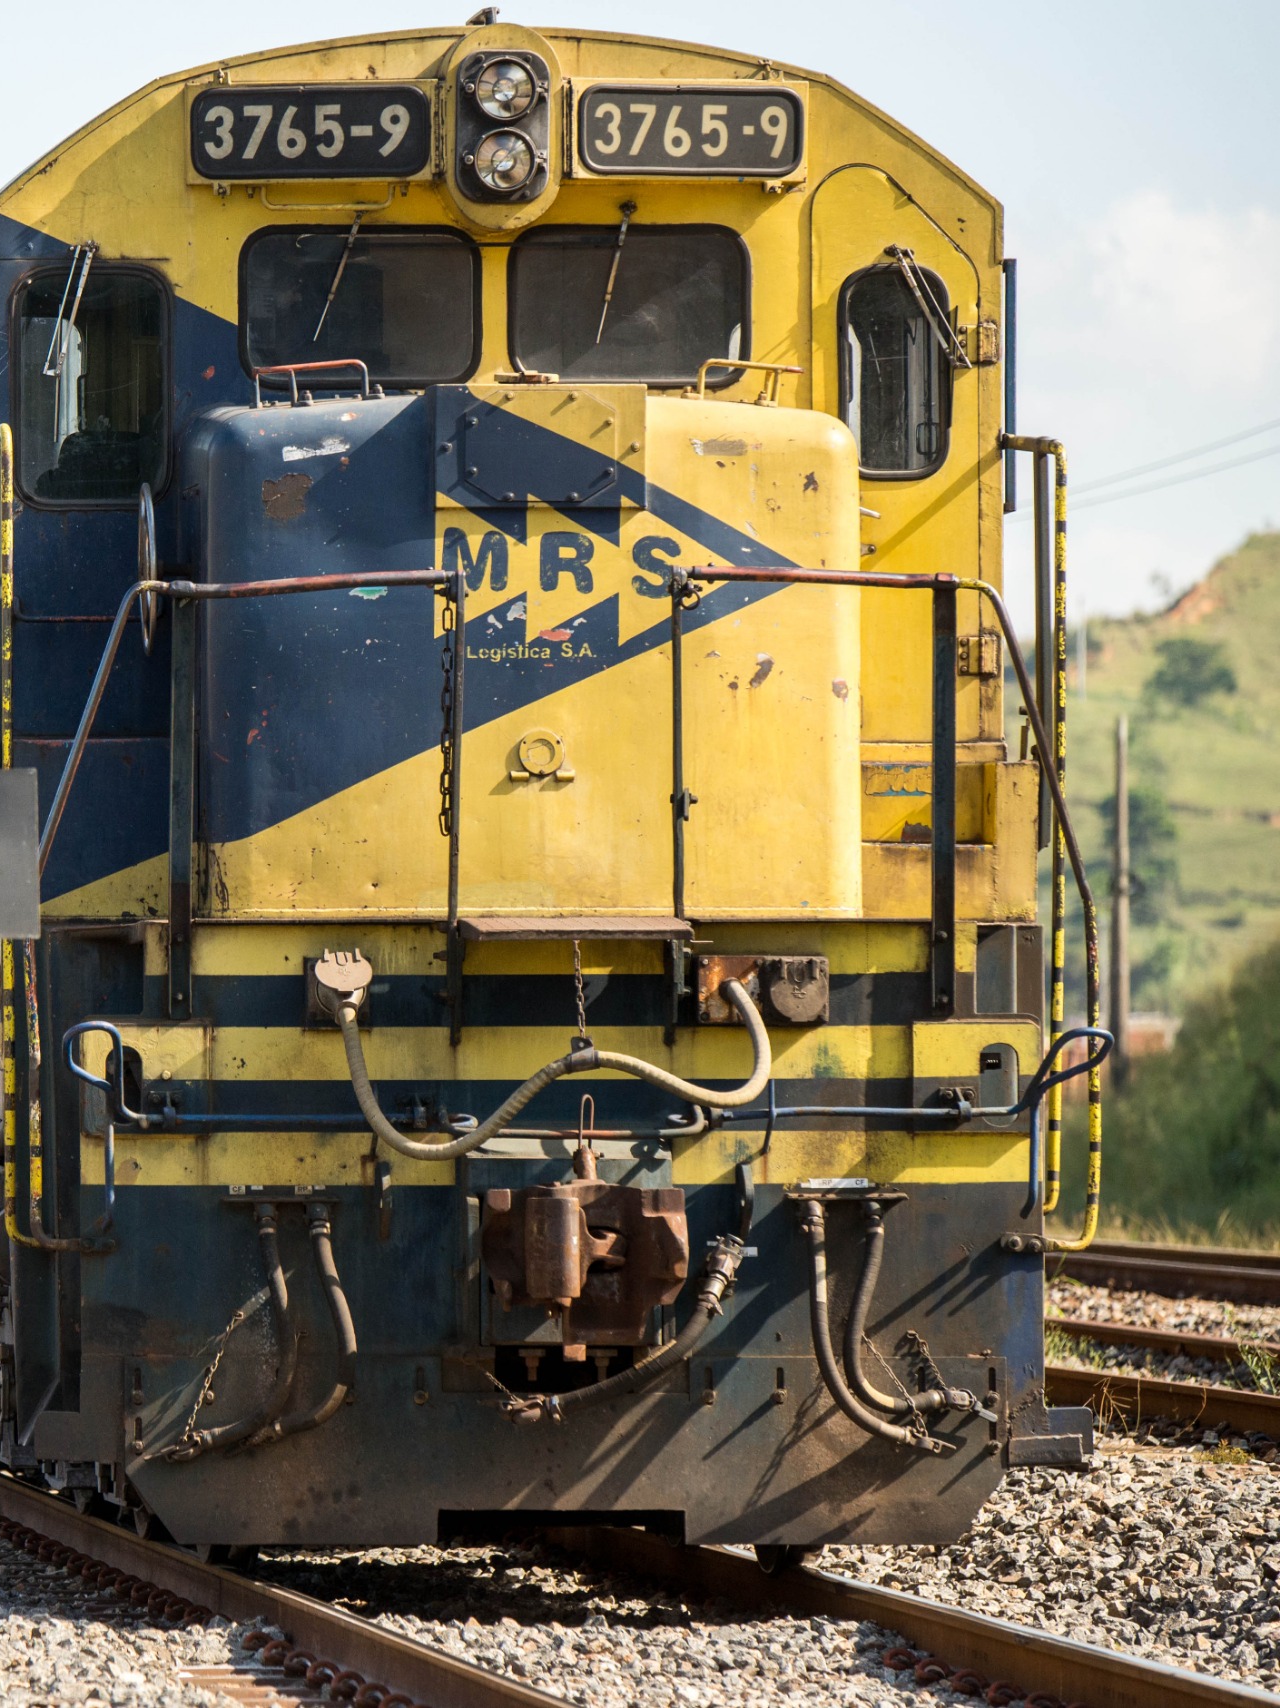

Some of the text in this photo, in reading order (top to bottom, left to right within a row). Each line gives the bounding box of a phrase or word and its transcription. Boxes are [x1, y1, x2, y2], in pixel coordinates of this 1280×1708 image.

[204, 103, 411, 160] 3765-9
[593, 102, 790, 159] 3765-9
[441, 526, 682, 599] MRS
[561, 641, 597, 658] S.A.
